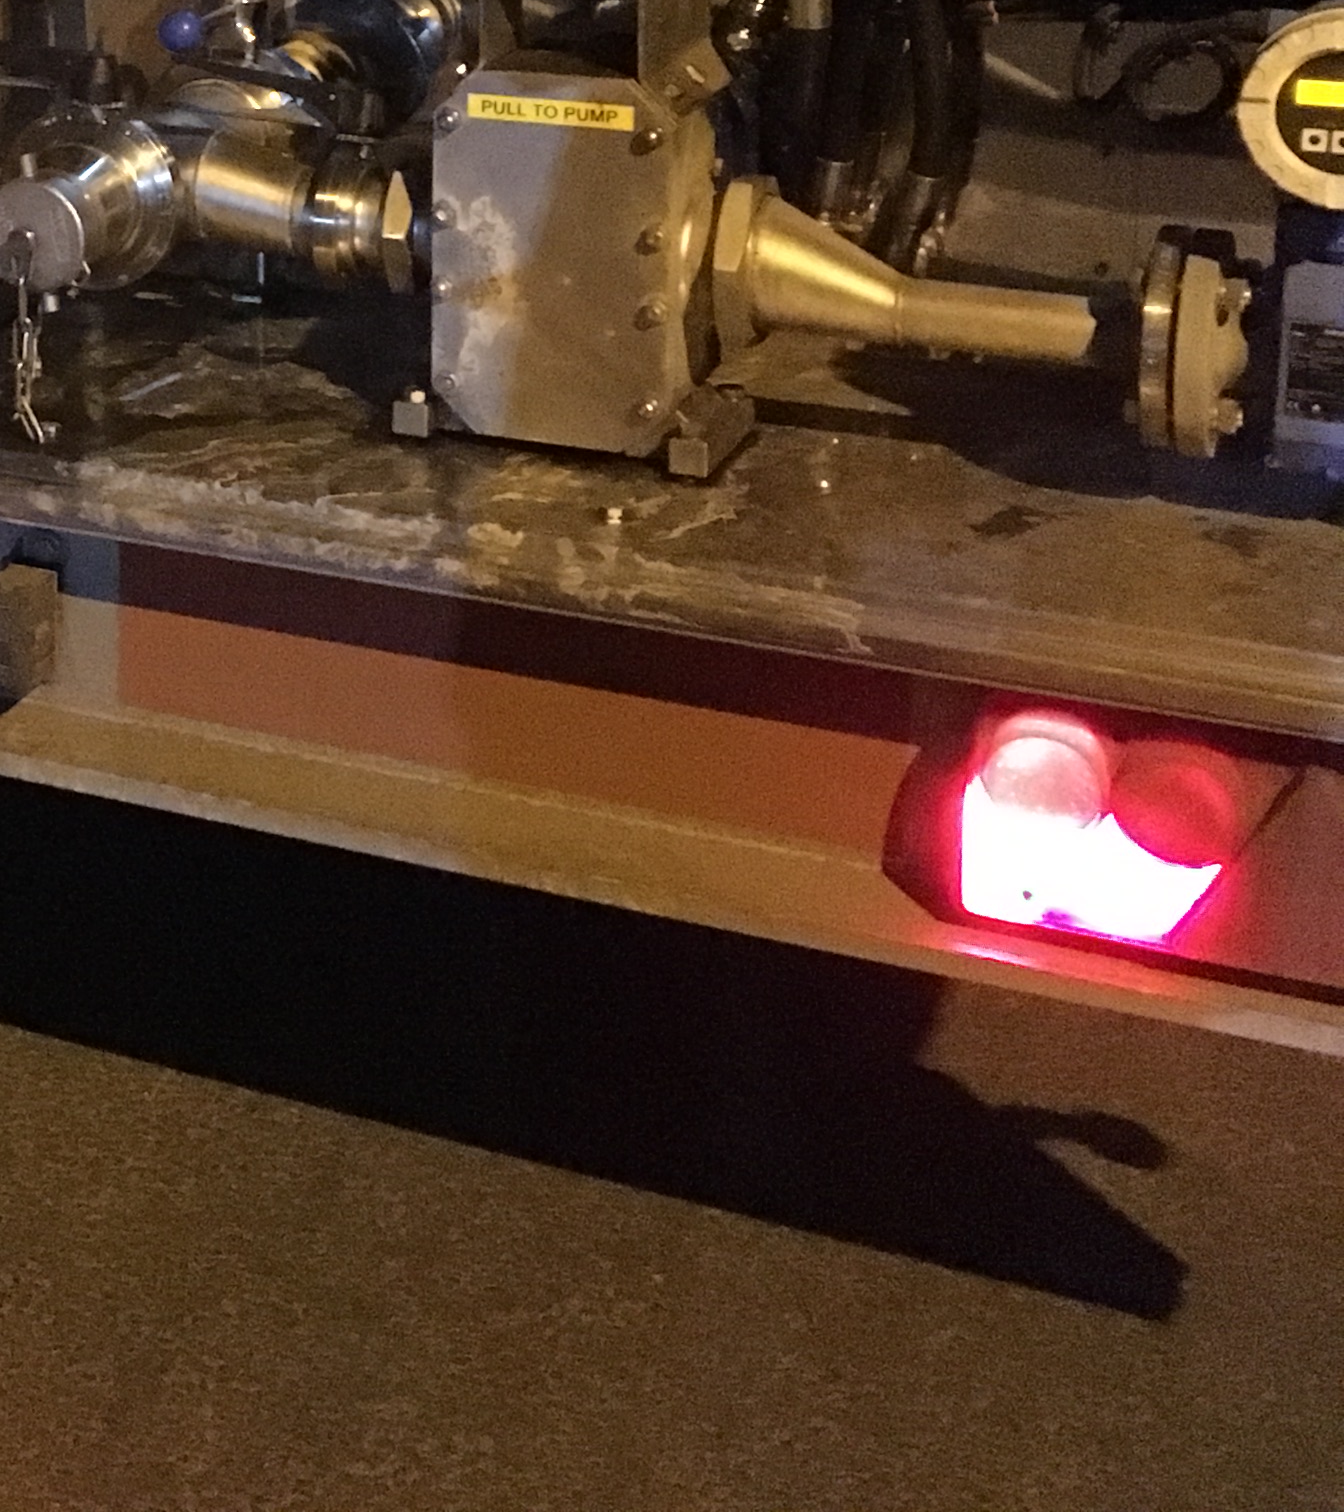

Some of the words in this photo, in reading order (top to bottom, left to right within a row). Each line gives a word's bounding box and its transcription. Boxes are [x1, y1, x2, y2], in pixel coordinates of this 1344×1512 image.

[480, 98, 526, 118] PULL
[533, 104, 559, 120] TO
[564, 105, 619, 124] PUMP
